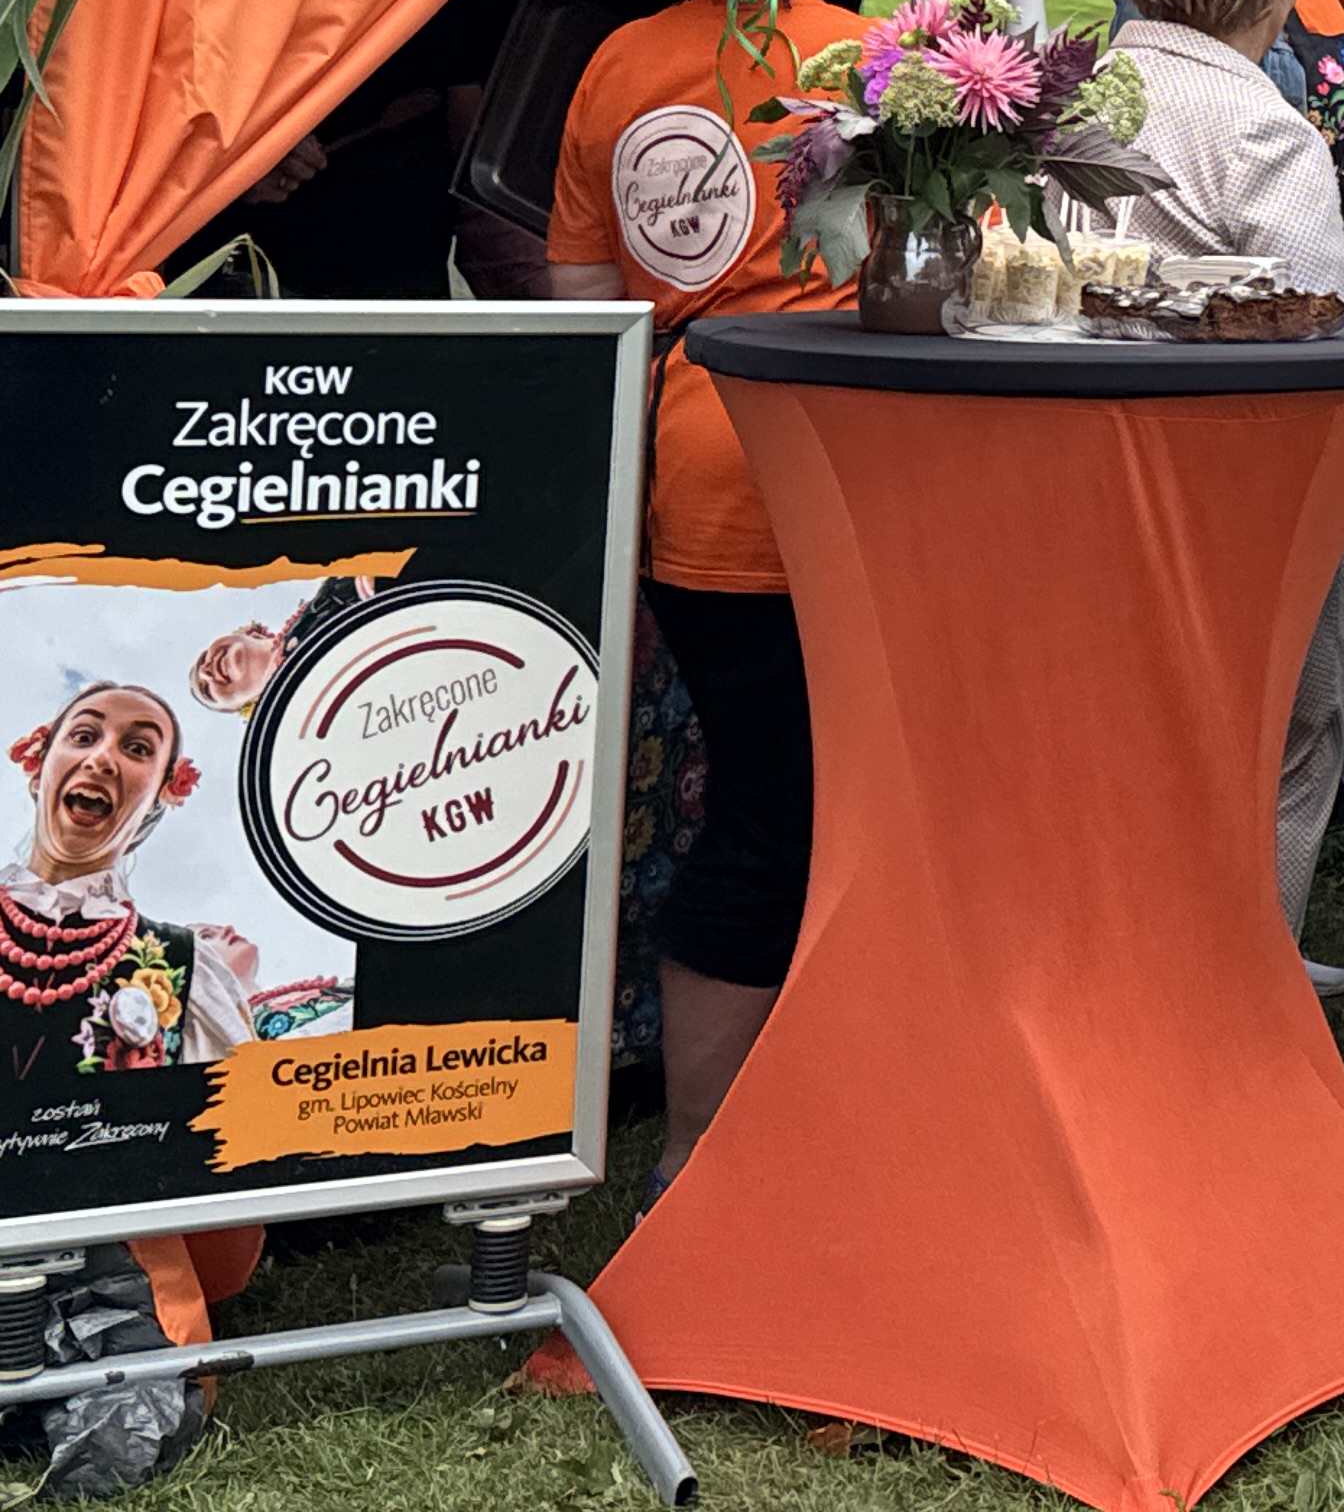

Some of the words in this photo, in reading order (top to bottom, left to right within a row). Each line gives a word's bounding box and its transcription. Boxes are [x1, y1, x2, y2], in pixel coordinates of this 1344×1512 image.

[669, 215, 701, 238] KGW
[263, 364, 353, 396] KGW
[171, 398, 438, 459] Zakręcone
[120, 458, 481, 530] Cegielnianki
[357, 667, 499, 740] Zakręcone
[284, 664, 591, 842] Cegielnianki
[421, 786, 495, 843] KGW
[271, 1047, 416, 1091] Cegielnia
[425, 1035, 548, 1080] Lewicka
[297, 1095, 334, 1121] gm.
[340, 1088, 425, 1118] Lipowiec
[430, 1076, 519, 1104] Kościelny
[333, 1112, 399, 1135] Powiat
[404, 1102, 483, 1127] Mławski
